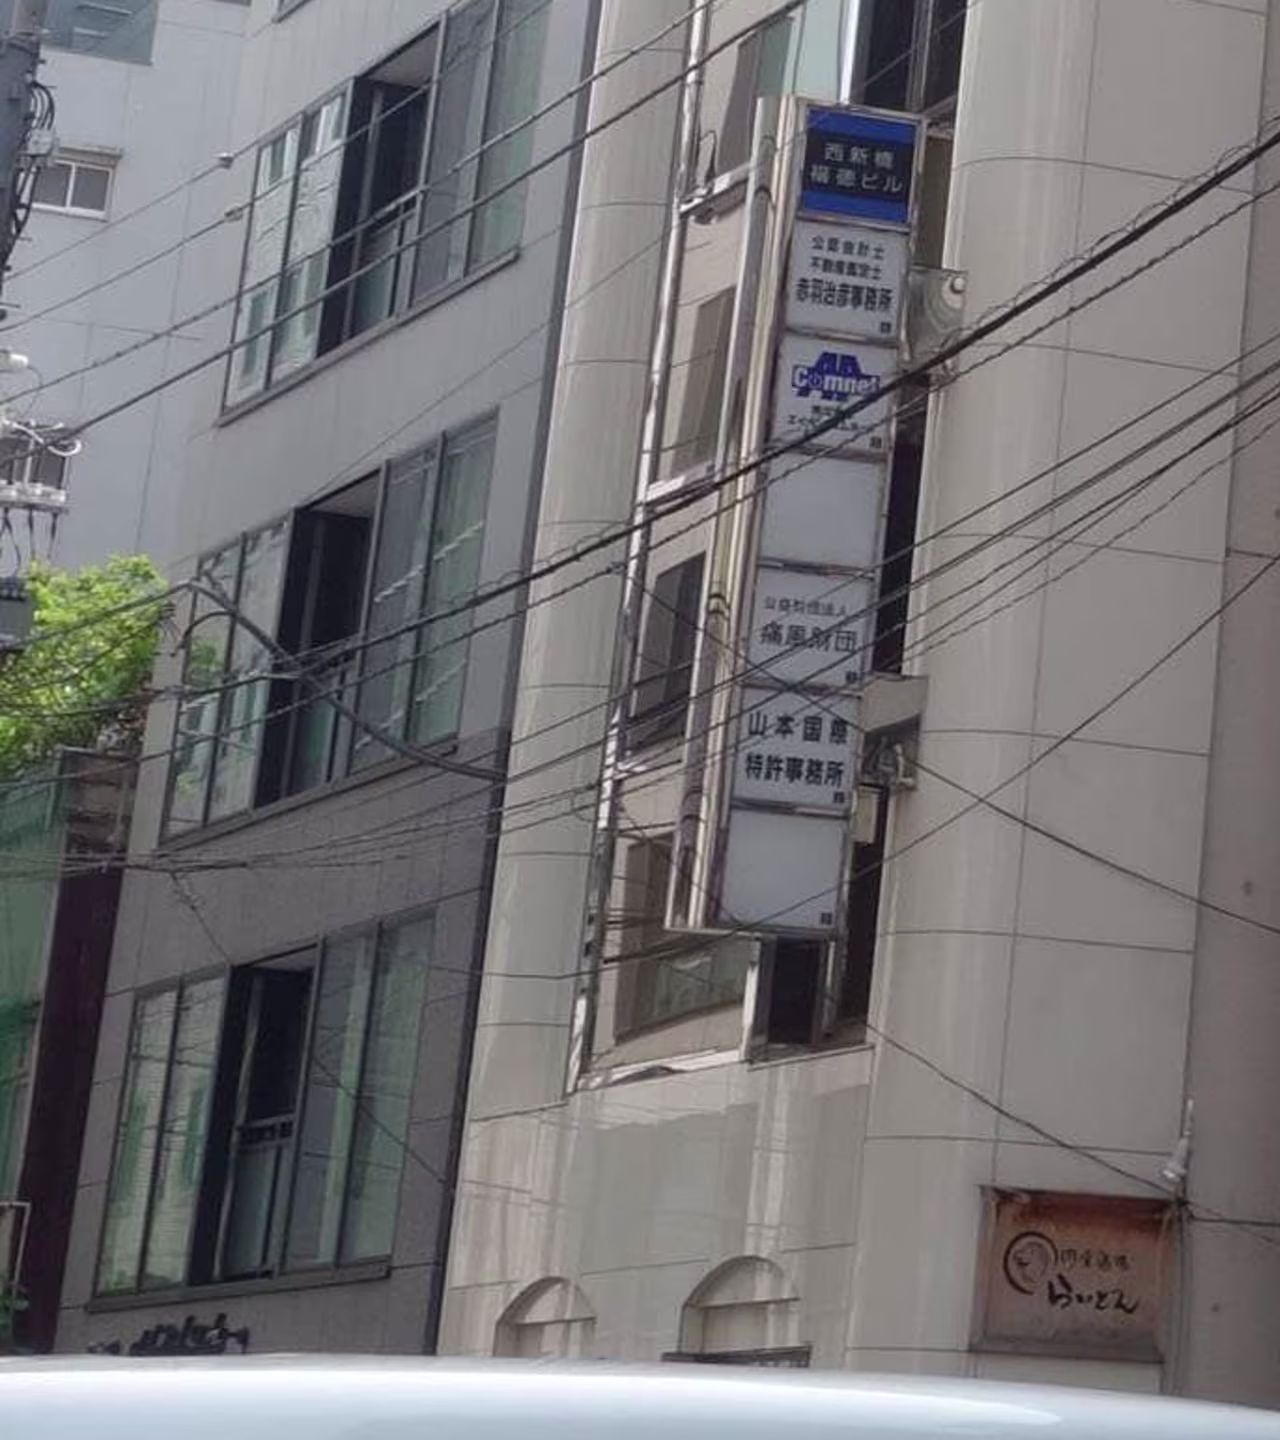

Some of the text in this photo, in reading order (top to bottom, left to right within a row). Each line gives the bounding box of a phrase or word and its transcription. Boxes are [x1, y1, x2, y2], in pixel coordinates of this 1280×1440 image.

[748, 711, 849, 744] 山本国際
[745, 754, 845, 788] 特許事務所
